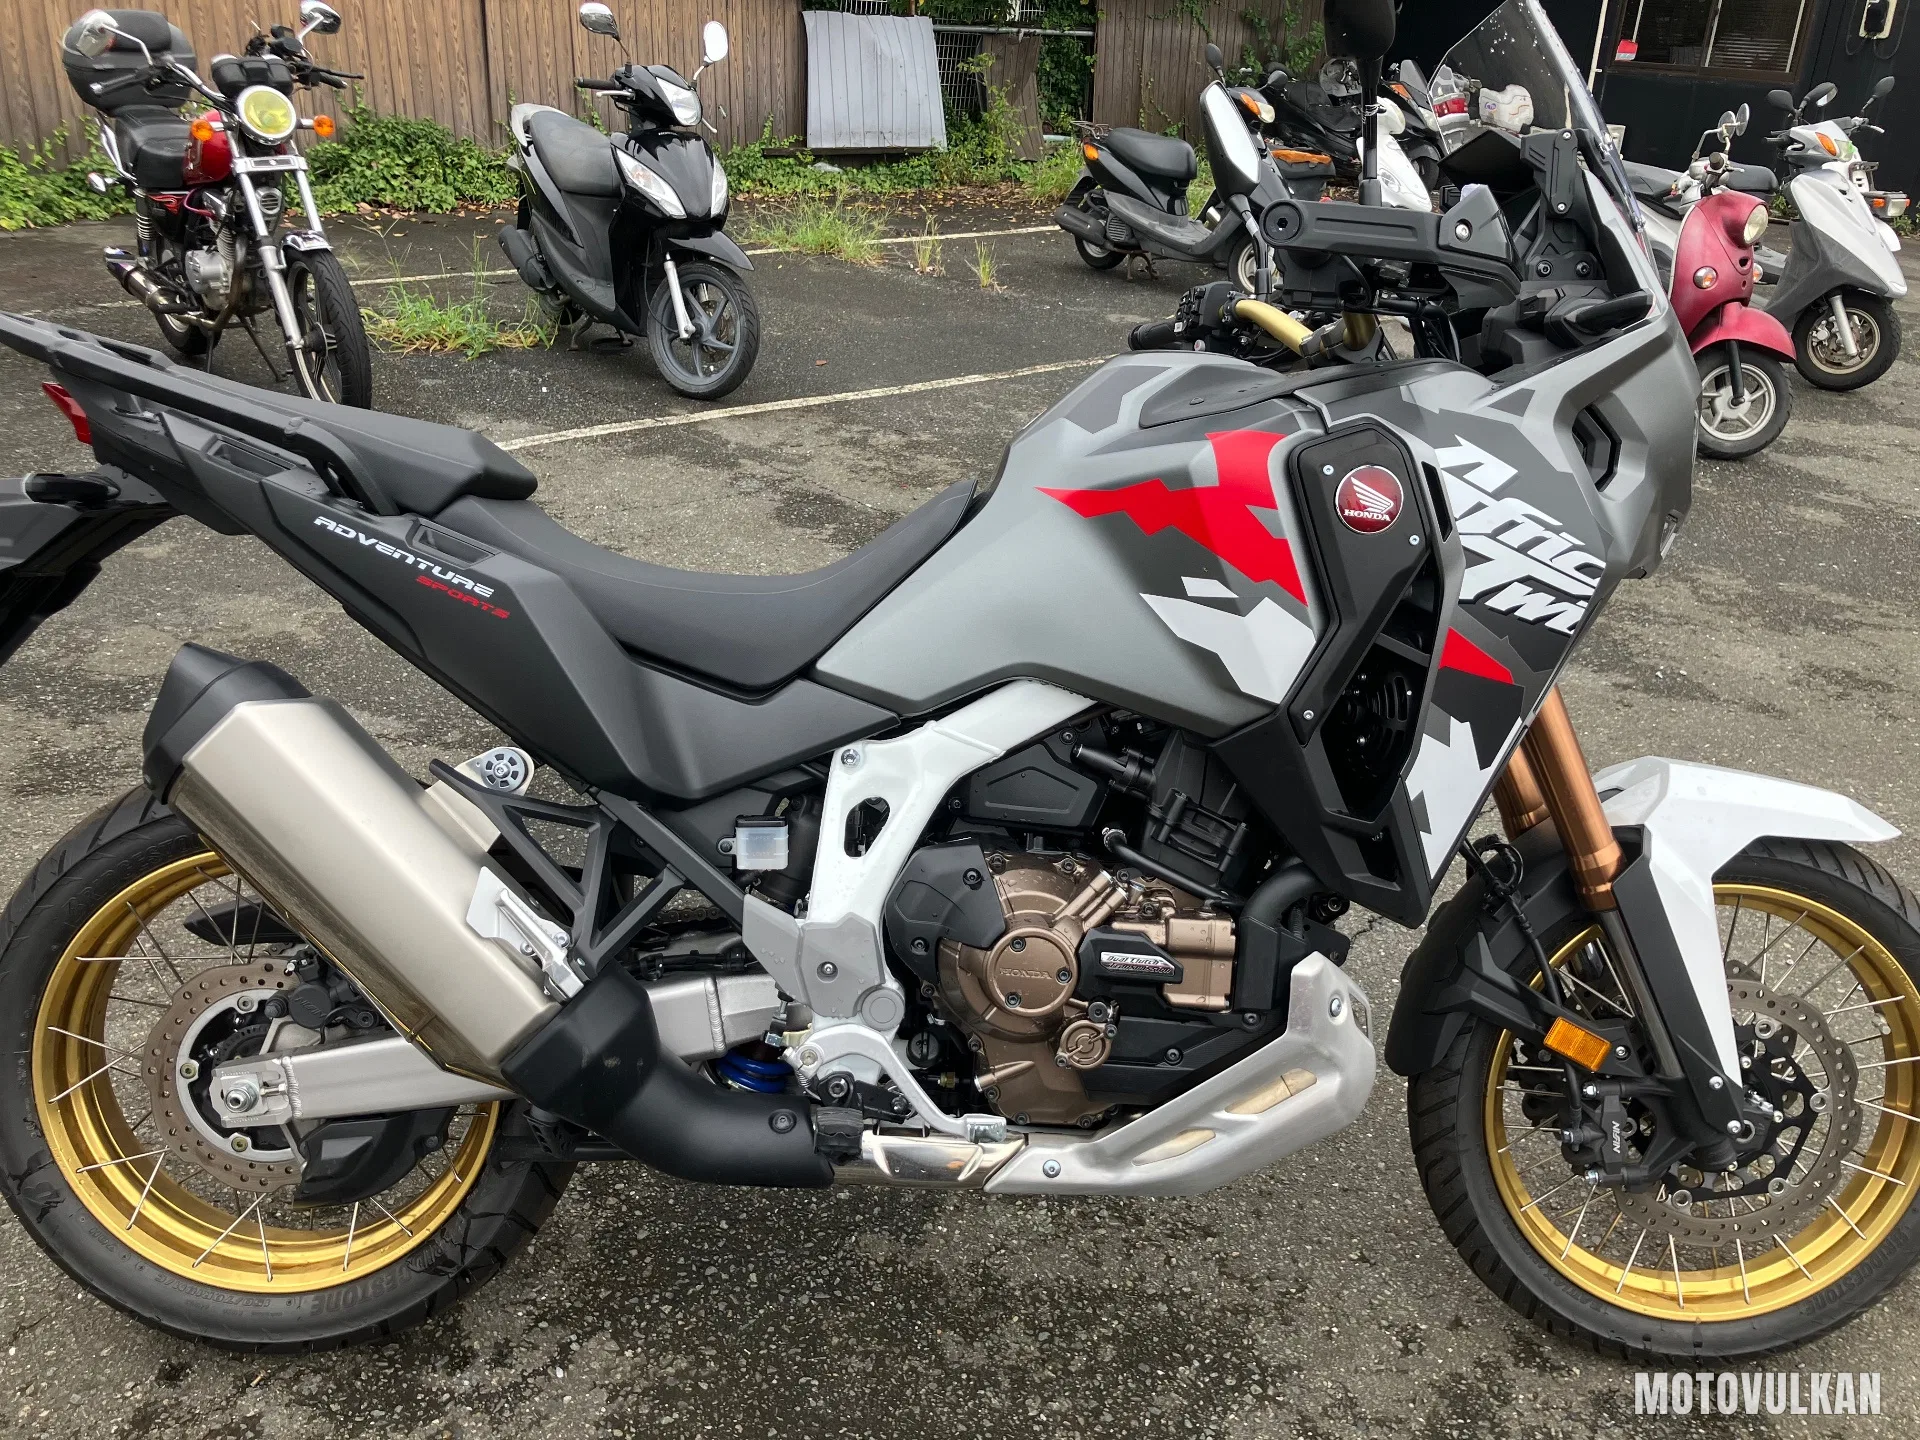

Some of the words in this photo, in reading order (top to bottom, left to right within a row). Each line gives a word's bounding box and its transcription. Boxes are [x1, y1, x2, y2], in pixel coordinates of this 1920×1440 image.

[1343, 508, 1391, 521] HONDA
[313, 516, 495, 598] ADVENTURE
[416, 575, 511, 619] SPORTS
[1130, 957, 1159, 965] Clutch
[1000, 967, 1053, 980] HONDA
